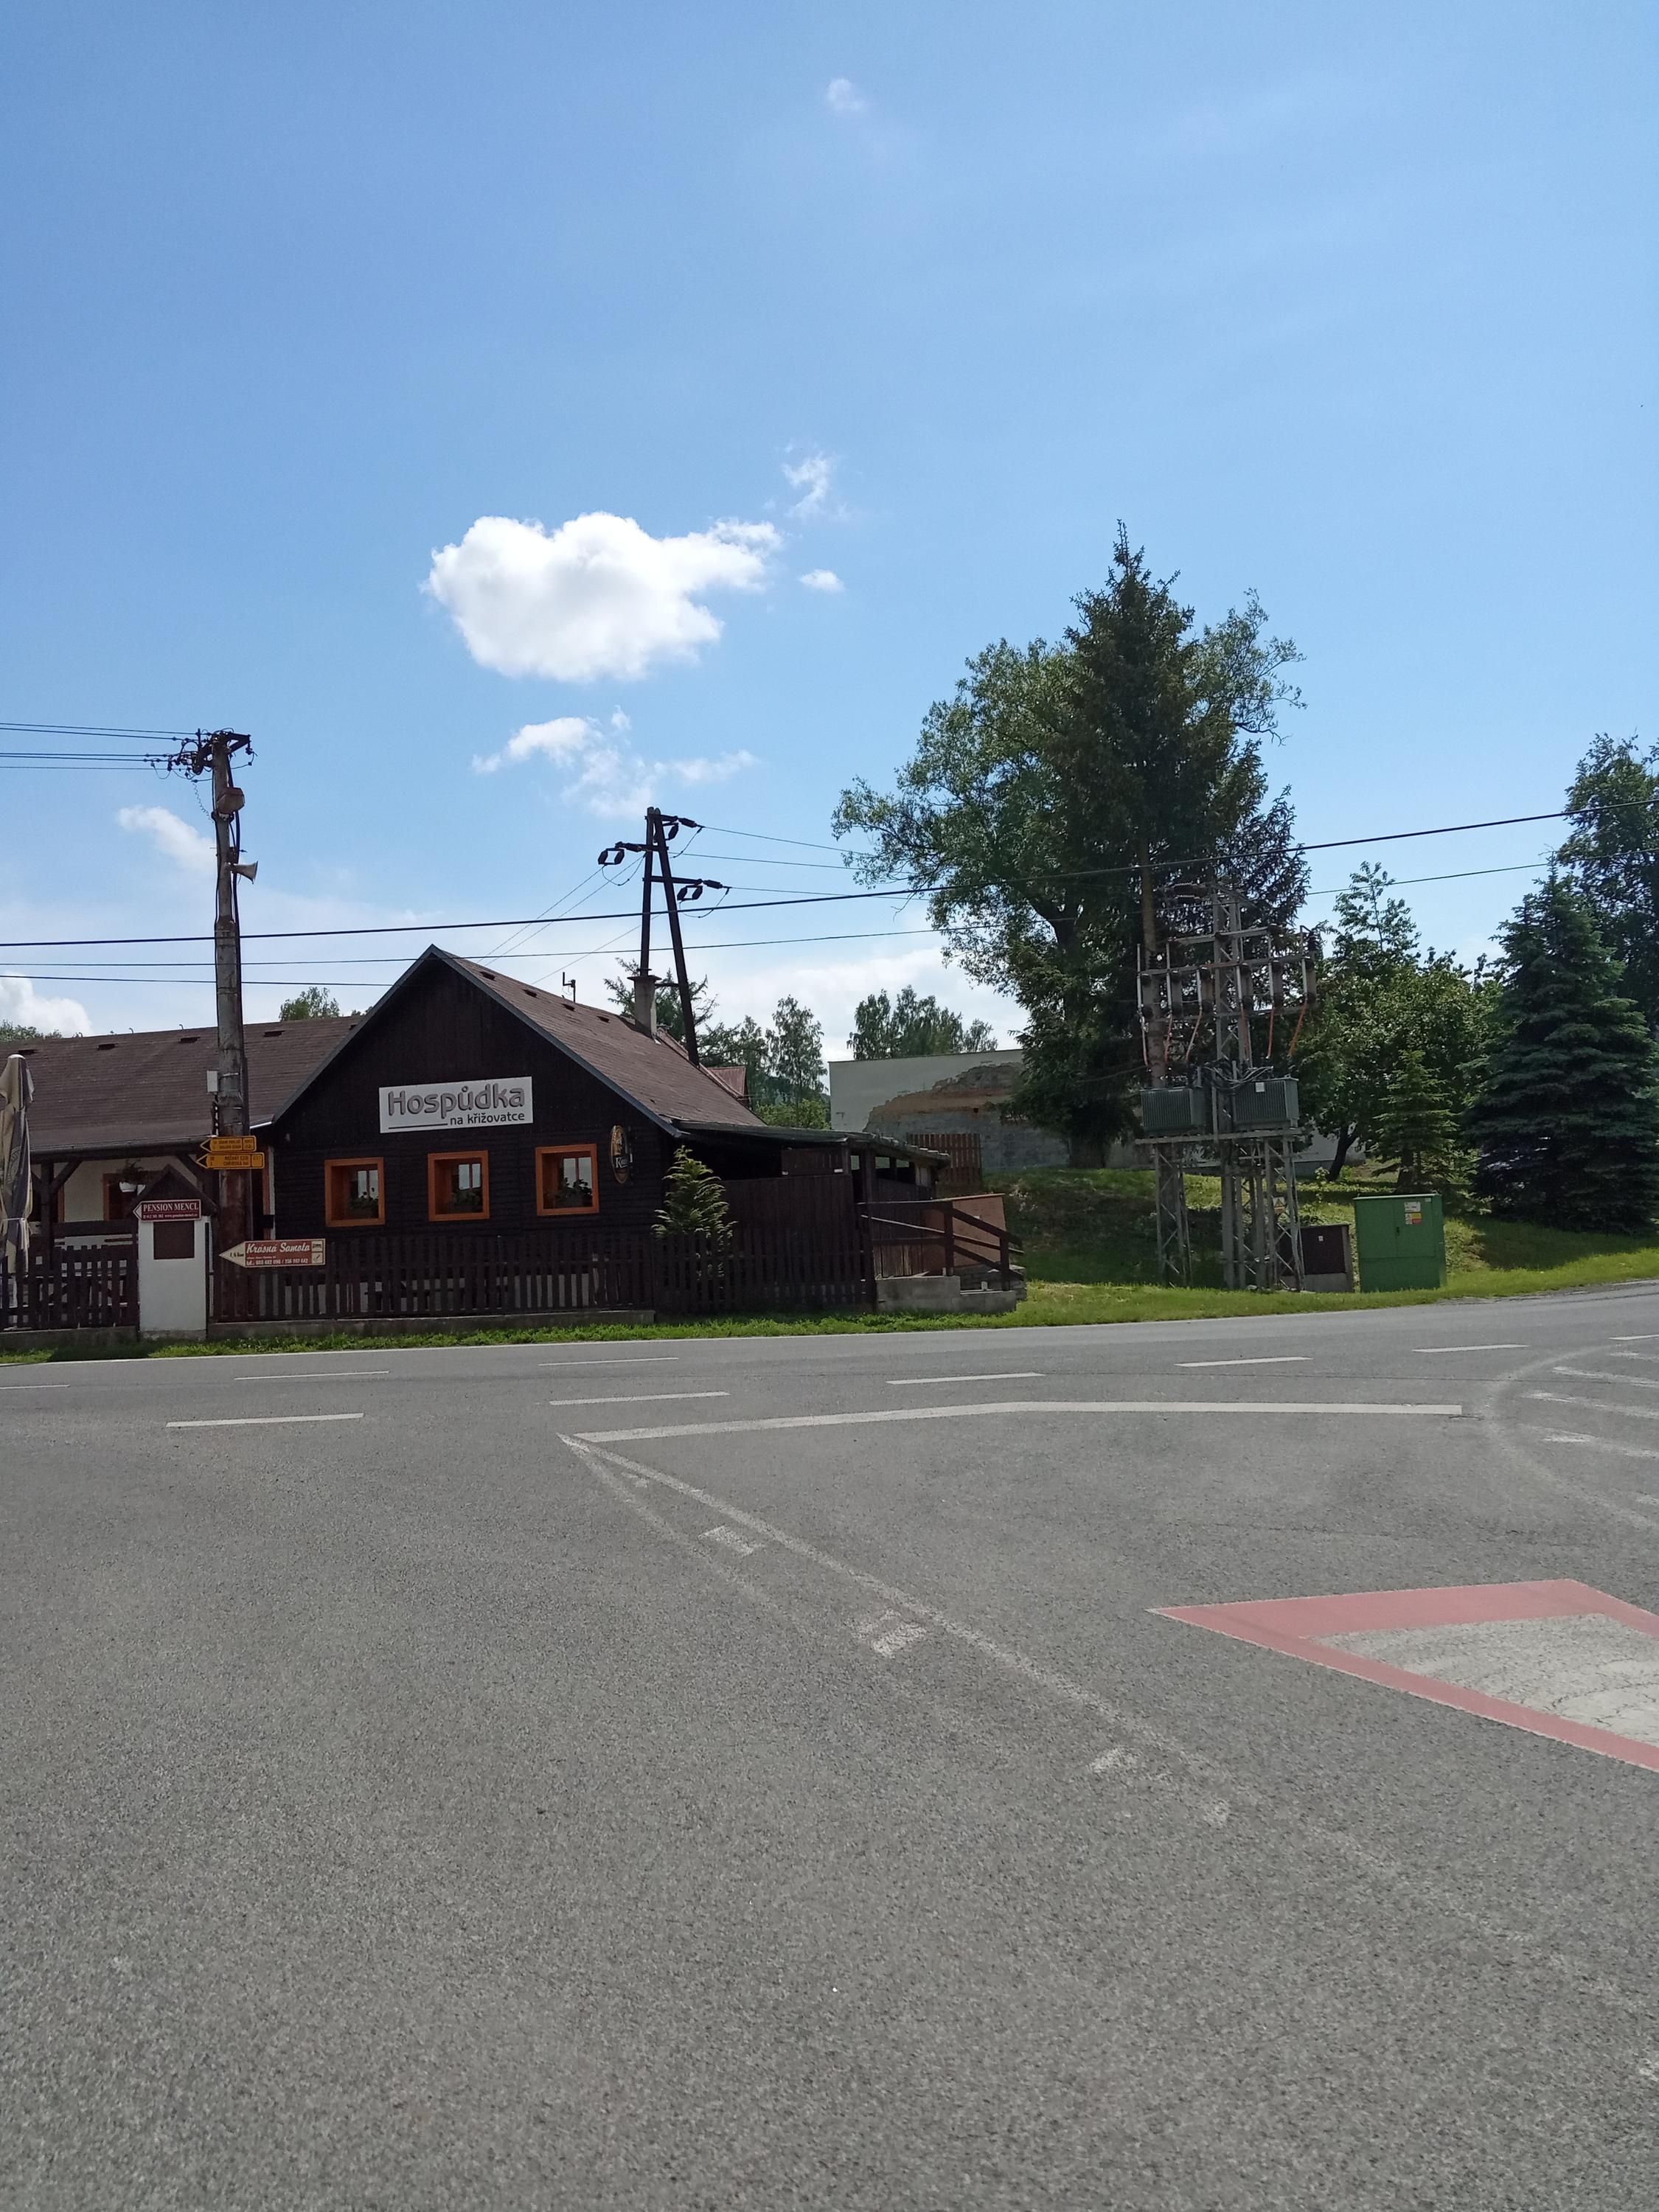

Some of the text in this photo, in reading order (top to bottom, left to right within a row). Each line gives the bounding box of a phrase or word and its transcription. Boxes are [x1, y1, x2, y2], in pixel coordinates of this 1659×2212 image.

[388, 1083, 526, 1119] Hospůdka
[450, 1112, 526, 1126] na křižovatce
[143, 1202, 199, 1212] PENSION MENCL
[246, 1242, 310, 1253] Krásná Samota
